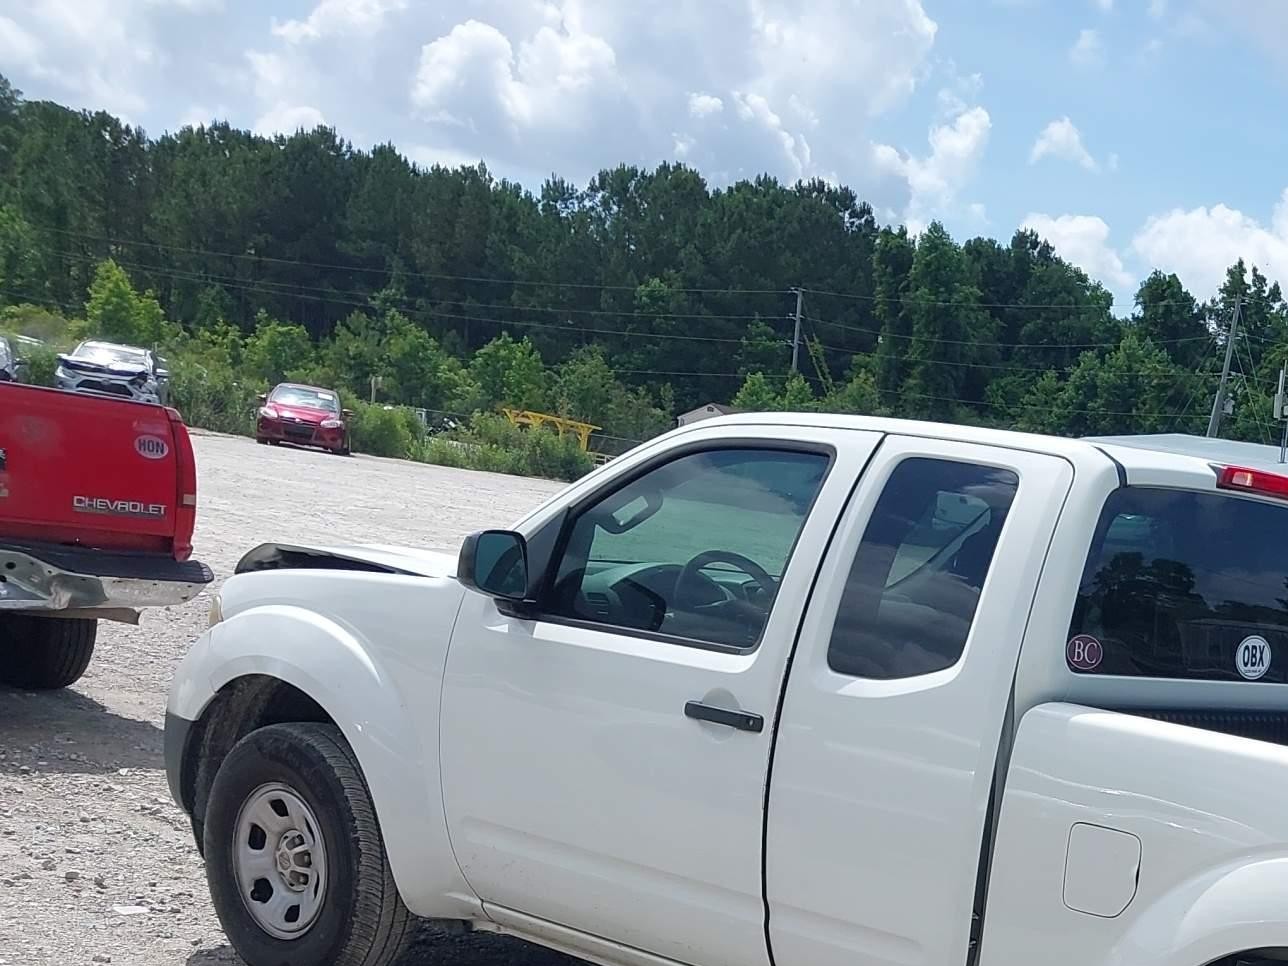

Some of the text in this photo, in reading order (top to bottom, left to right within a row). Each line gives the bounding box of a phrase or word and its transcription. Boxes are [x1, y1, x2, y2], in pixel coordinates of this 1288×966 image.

[138, 438, 165, 455] HON
[73, 495, 168, 515] CHEVROLET
[1072, 640, 1098, 664] BC
[1242, 644, 1266, 668] OBX
